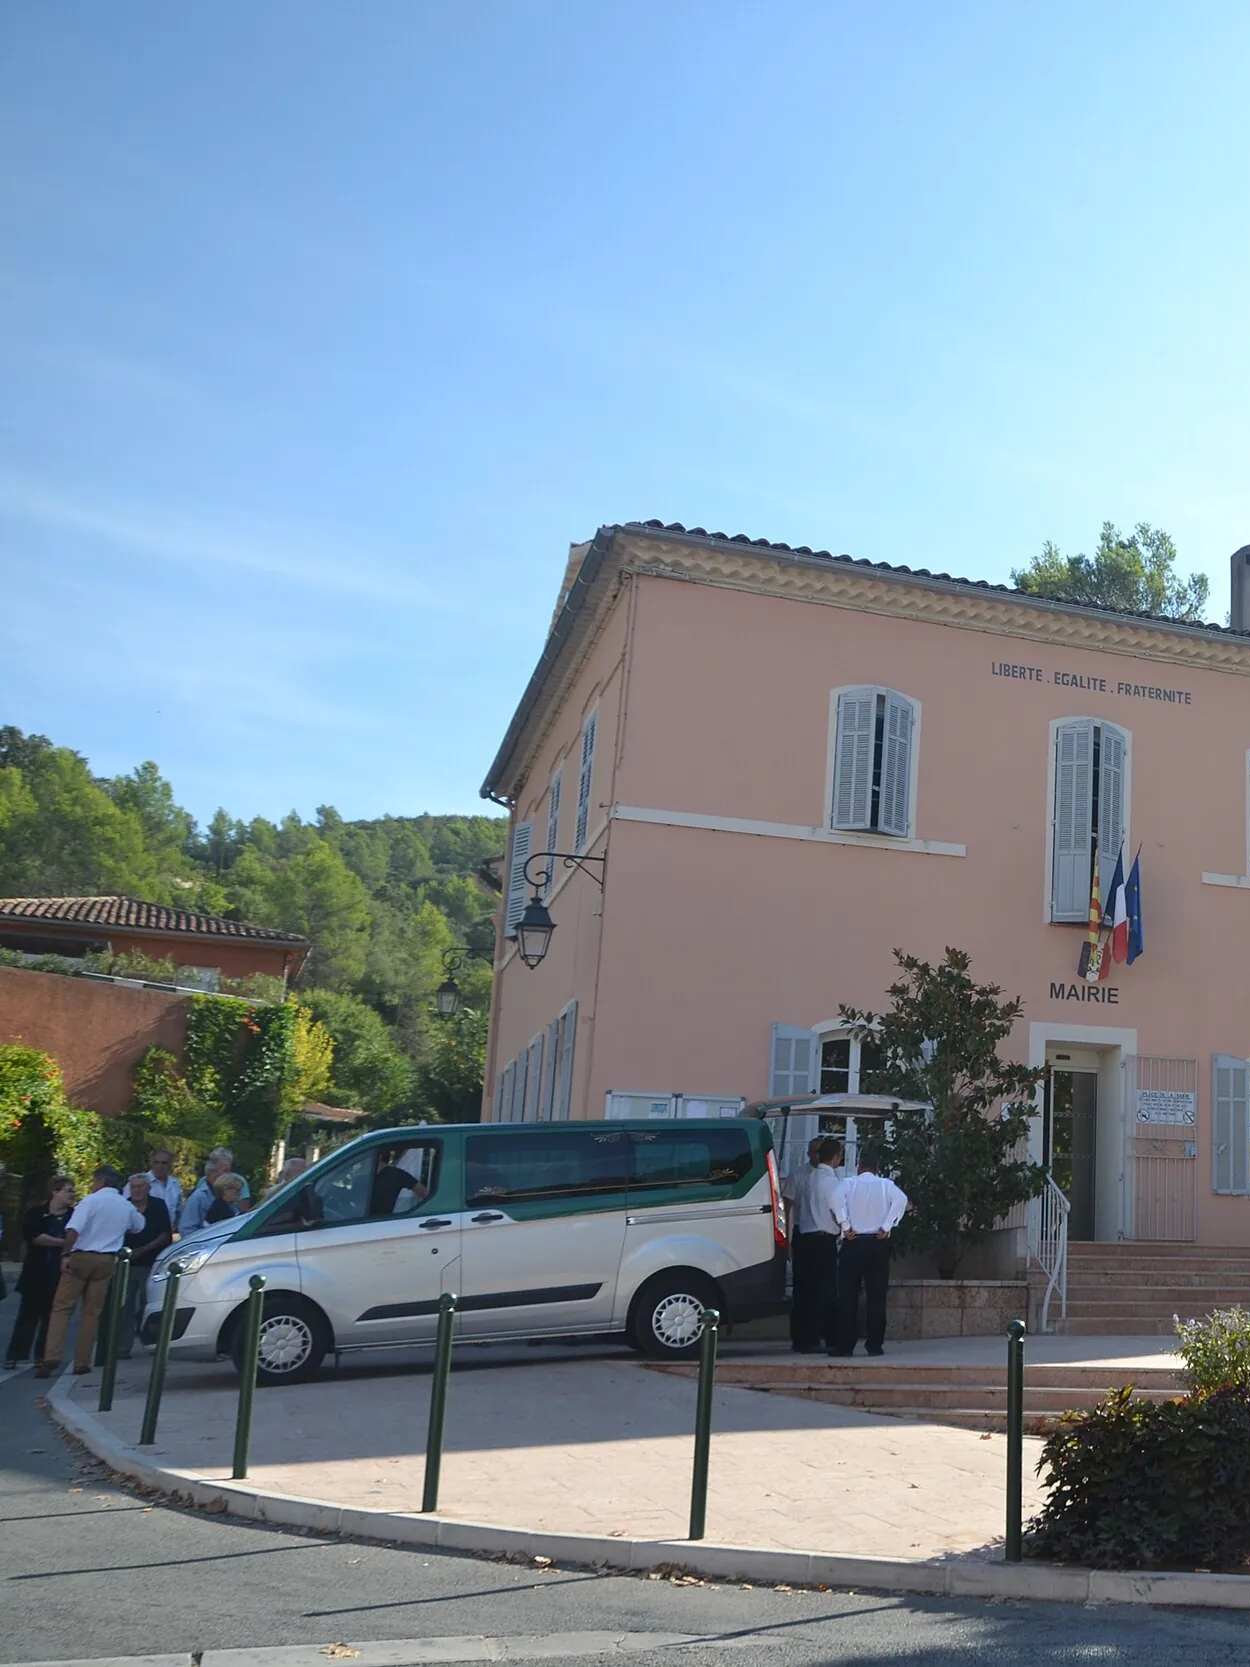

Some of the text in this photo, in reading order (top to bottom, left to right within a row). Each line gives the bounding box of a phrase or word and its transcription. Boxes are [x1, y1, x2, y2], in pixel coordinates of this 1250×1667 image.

[992, 662, 1042, 681] LIBERTE
[1054, 671, 1106, 692] EGALITE
[1117, 682, 1192, 704] FRATERNITE
[1050, 982, 1119, 1004] MAIRIE
